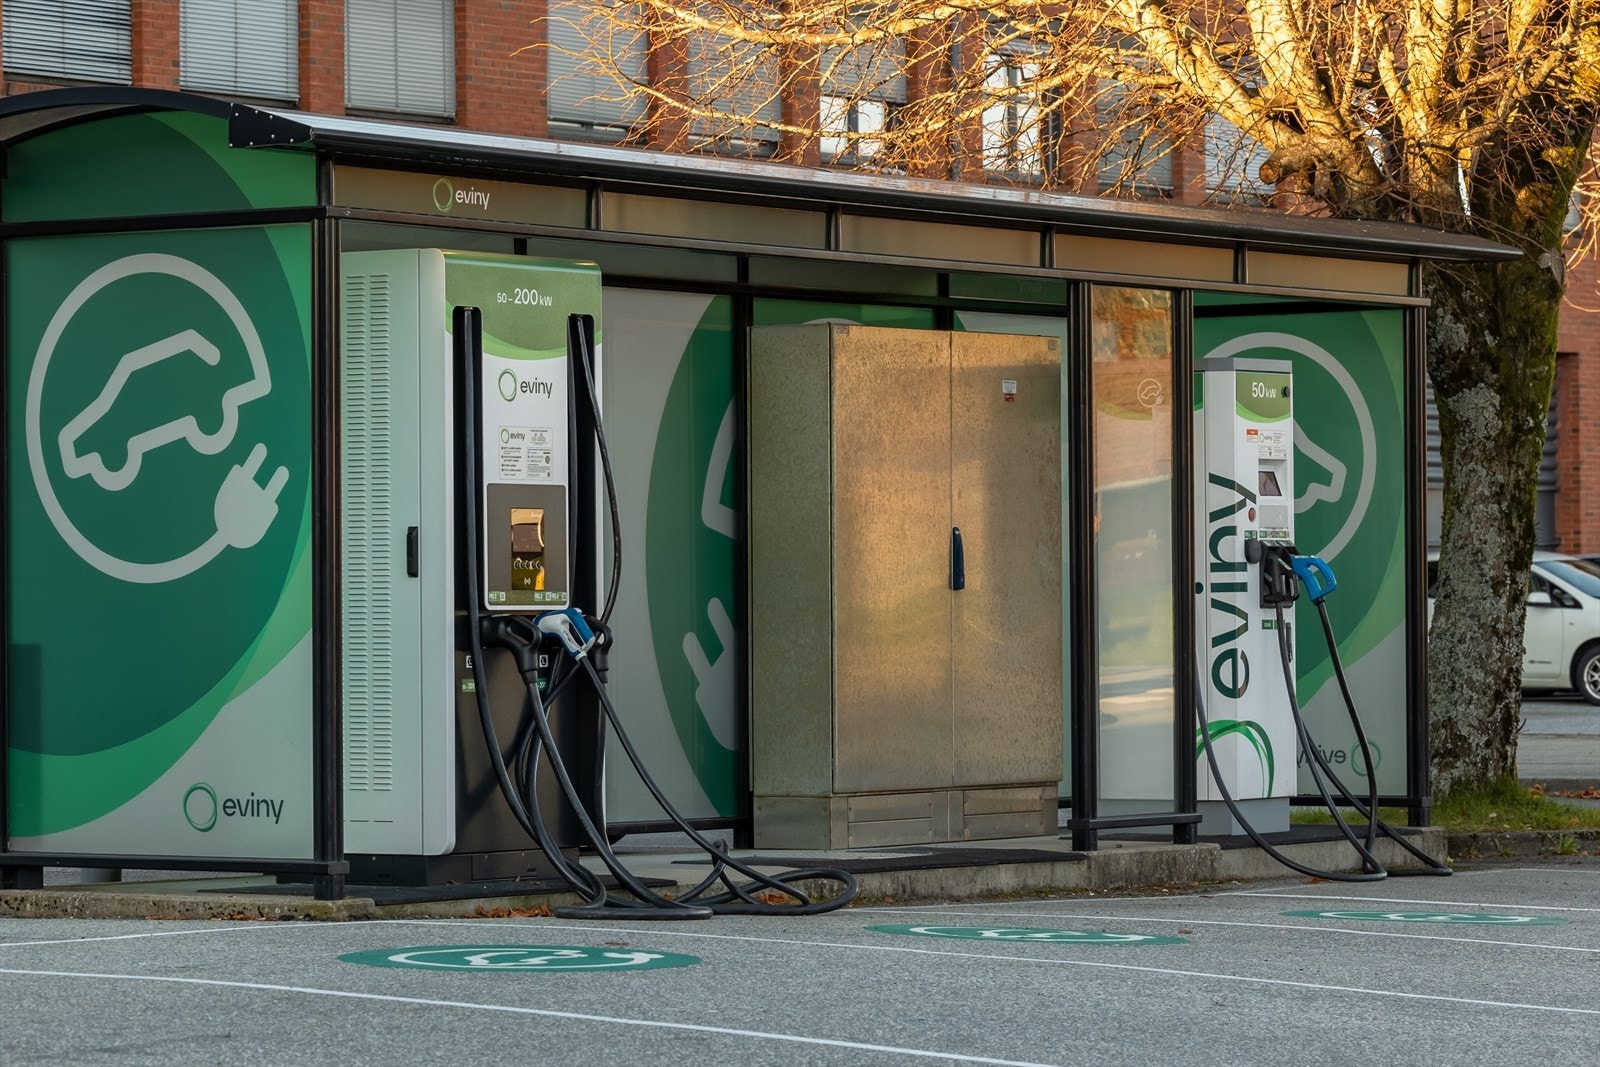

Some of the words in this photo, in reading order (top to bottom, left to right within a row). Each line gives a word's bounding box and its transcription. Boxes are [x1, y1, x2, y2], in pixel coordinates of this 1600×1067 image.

[455, 186, 490, 210] eviny
[496, 293, 508, 303] 50
[514, 288, 538, 305] 200
[539, 296, 553, 306] kW
[520, 377, 553, 399] eviny
[1252, 381, 1265, 398] 50
[1265, 387, 1277, 399] kW
[510, 431, 526, 442] eviny
[1195, 472, 1256, 699] eviny
[222, 792, 284, 825] eviny
